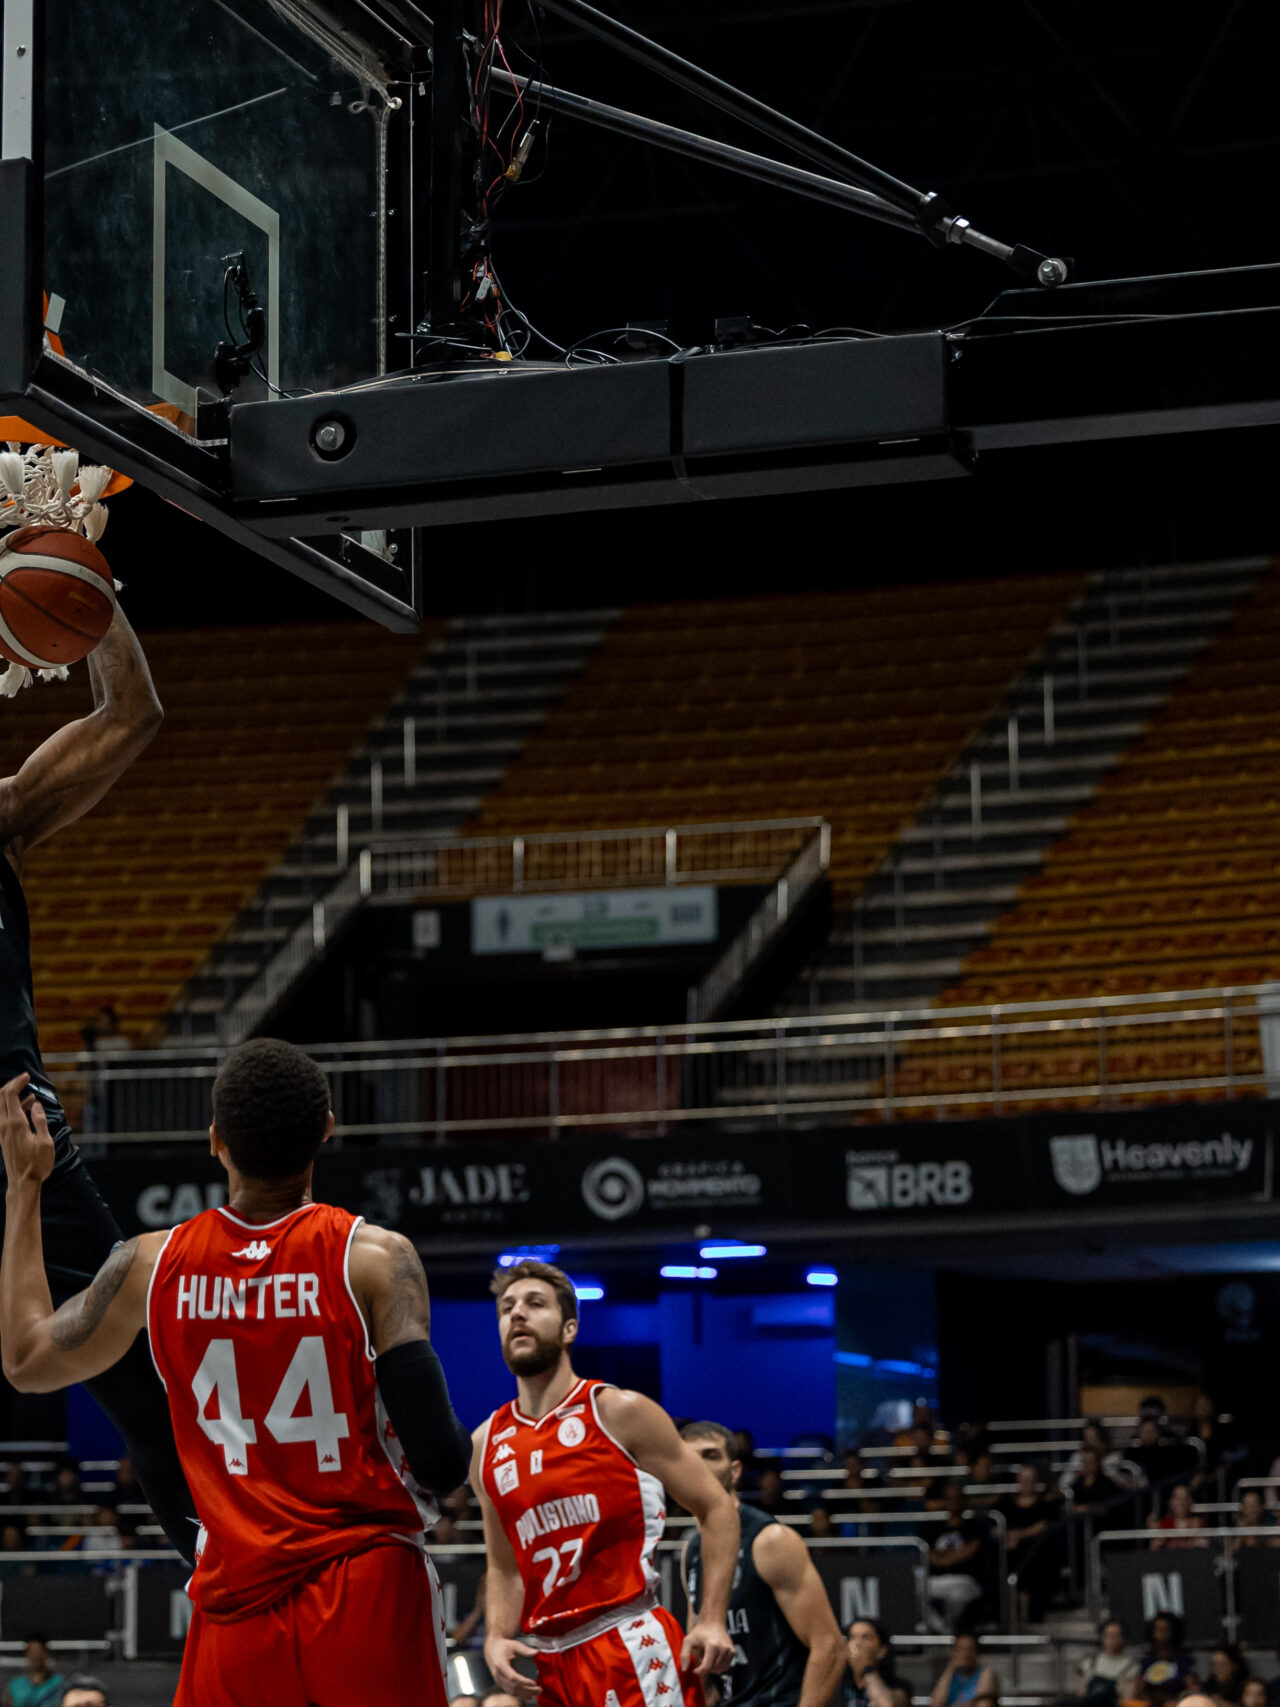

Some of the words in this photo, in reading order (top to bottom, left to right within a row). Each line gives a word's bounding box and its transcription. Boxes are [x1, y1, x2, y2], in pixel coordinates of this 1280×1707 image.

[1100, 1131, 1254, 1172] Heavenly
[408, 1163, 531, 1205] JADE
[891, 1160, 974, 1208] BRB
[176, 1272, 321, 1320] HUNTER
[191, 1335, 351, 1477] 44
[840, 1576, 880, 1628] N
[1142, 1571, 1185, 1622] N
